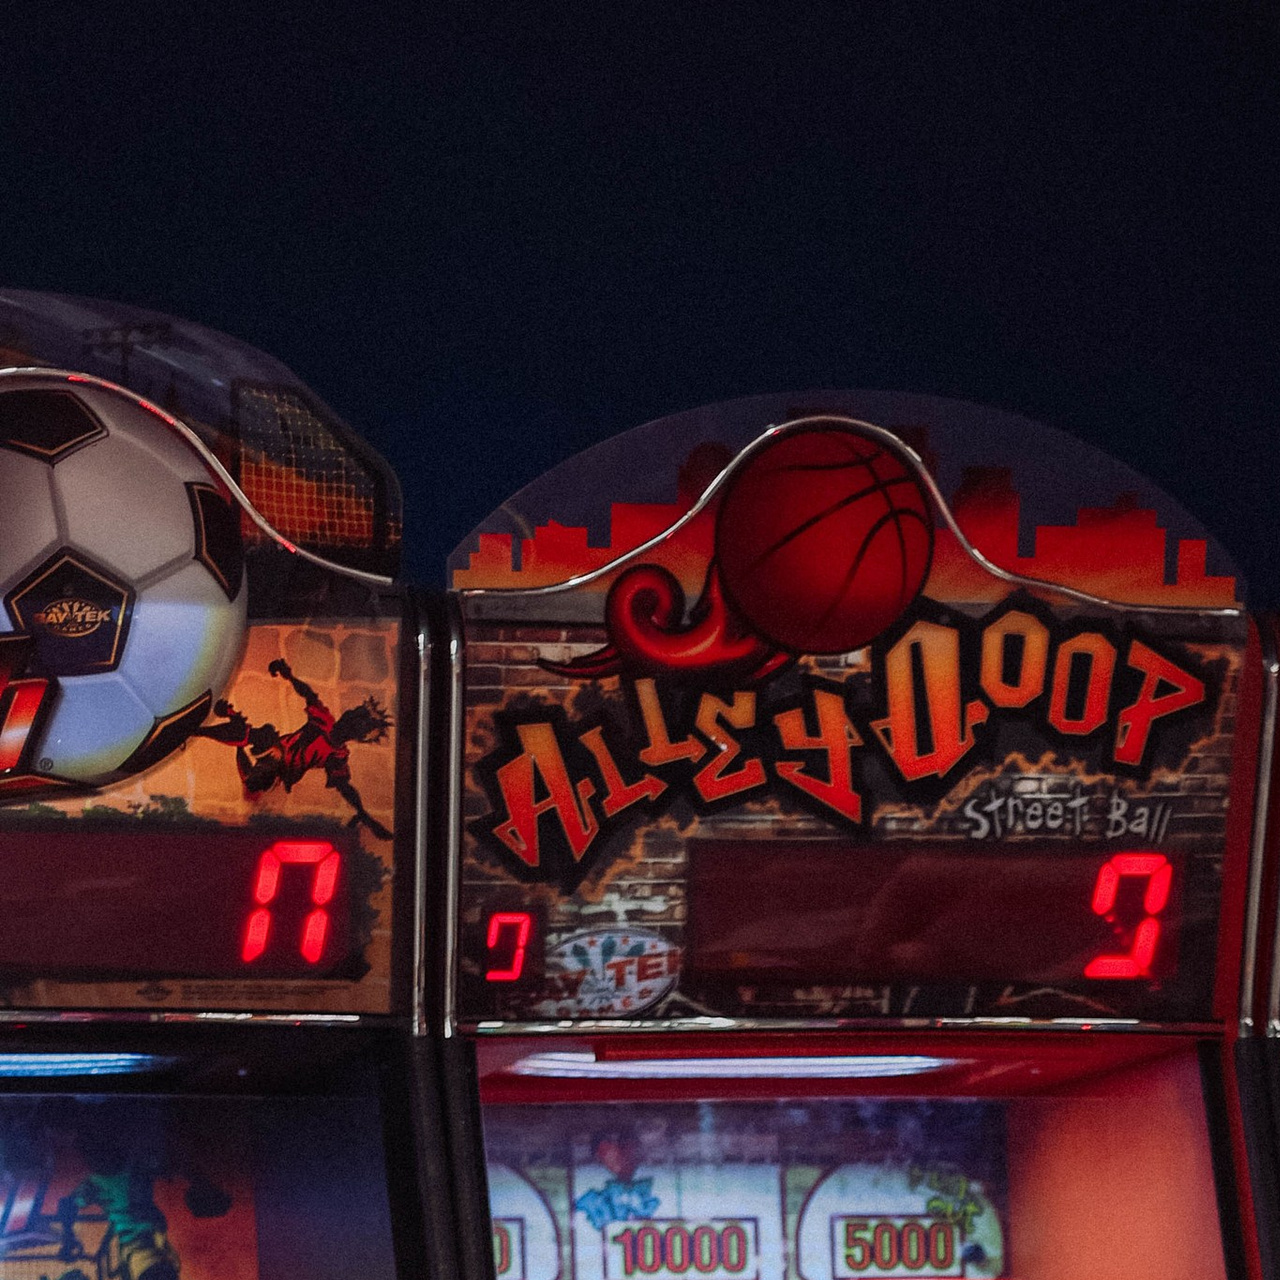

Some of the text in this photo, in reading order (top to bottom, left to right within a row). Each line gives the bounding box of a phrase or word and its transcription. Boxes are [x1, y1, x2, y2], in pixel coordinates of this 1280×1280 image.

[964, 788, 1172, 843] Street Ball
[613, 1225, 746, 1276] 10000
[846, 1222, 954, 1270] 5000
